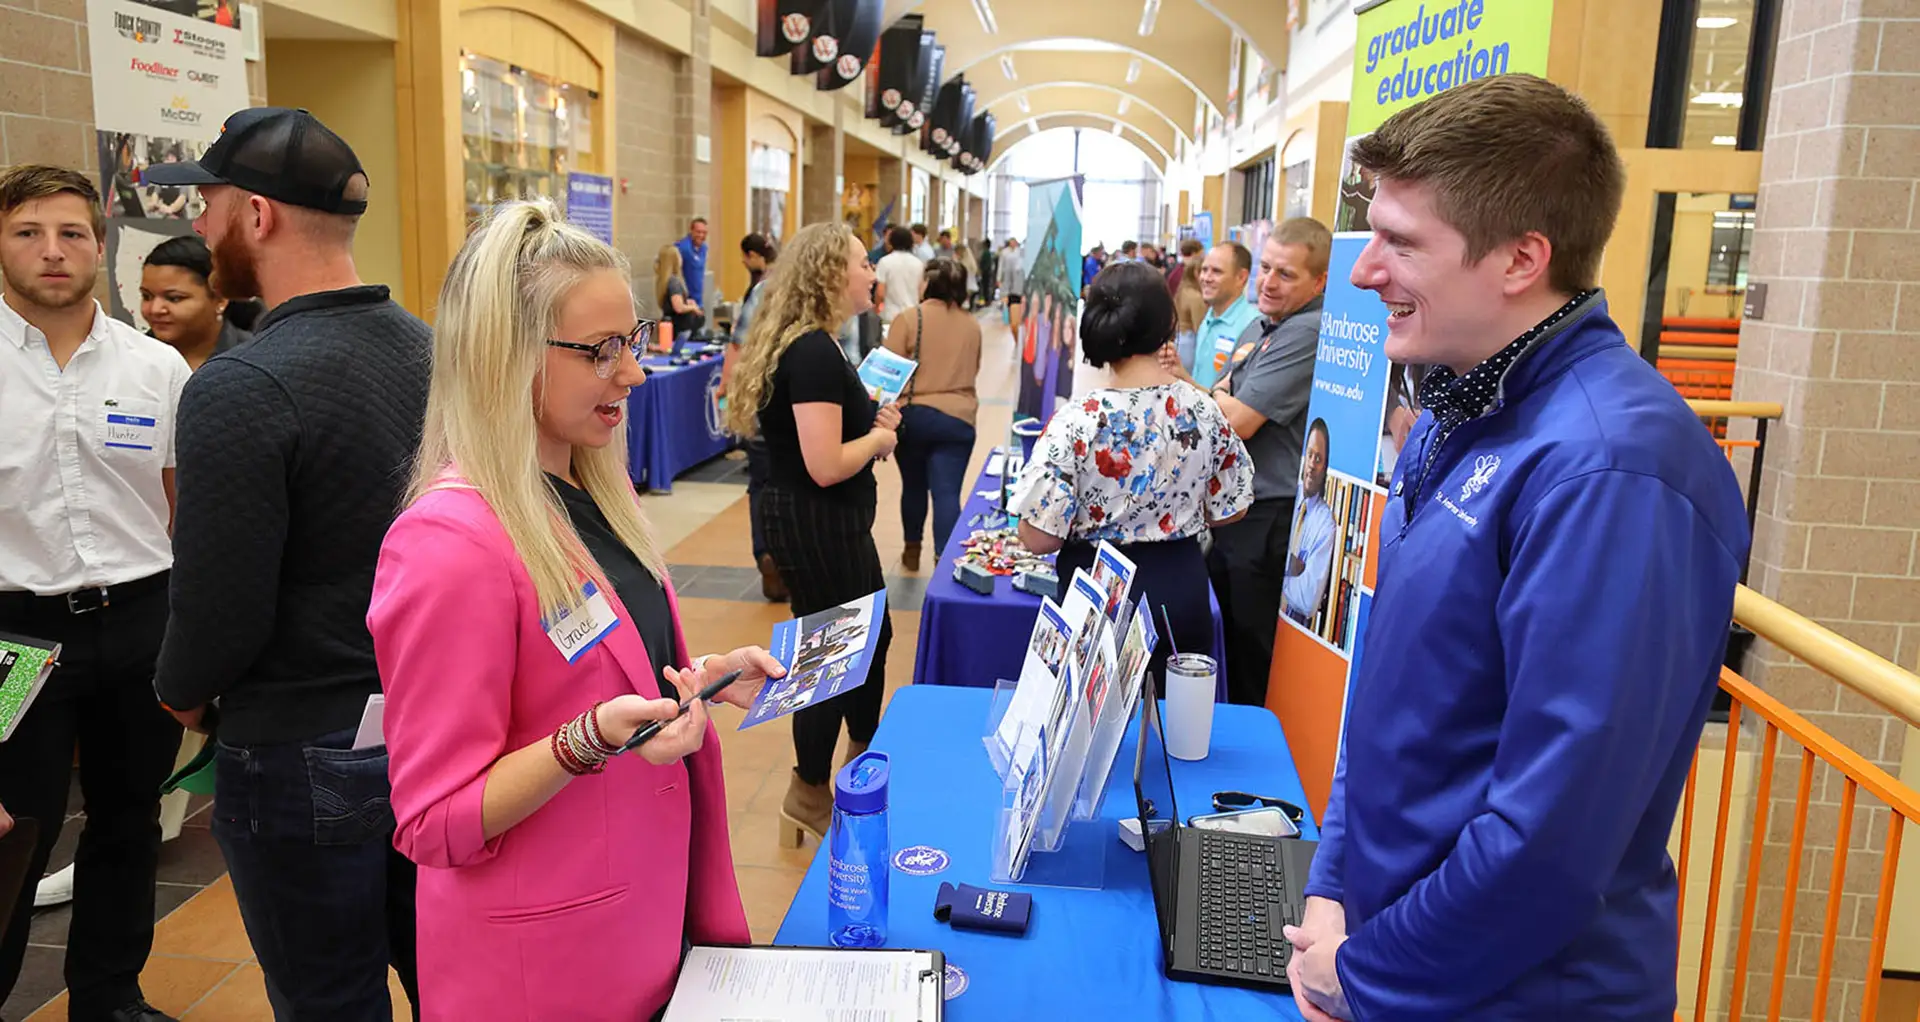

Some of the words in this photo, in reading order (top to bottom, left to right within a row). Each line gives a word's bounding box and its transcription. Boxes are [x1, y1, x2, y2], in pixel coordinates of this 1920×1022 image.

[183, 31, 225, 48] Stoops
[1365, 0, 1484, 74] graduate
[130, 57, 179, 77] Foodliner
[1376, 39, 1510, 105] education
[161, 107, 202, 122] McCOY
[1316, 337, 1374, 378] University
[1315, 379, 1364, 401] www.sau.edu
[107, 425, 141, 440] Hunter
[555, 617, 598, 650] Grace
